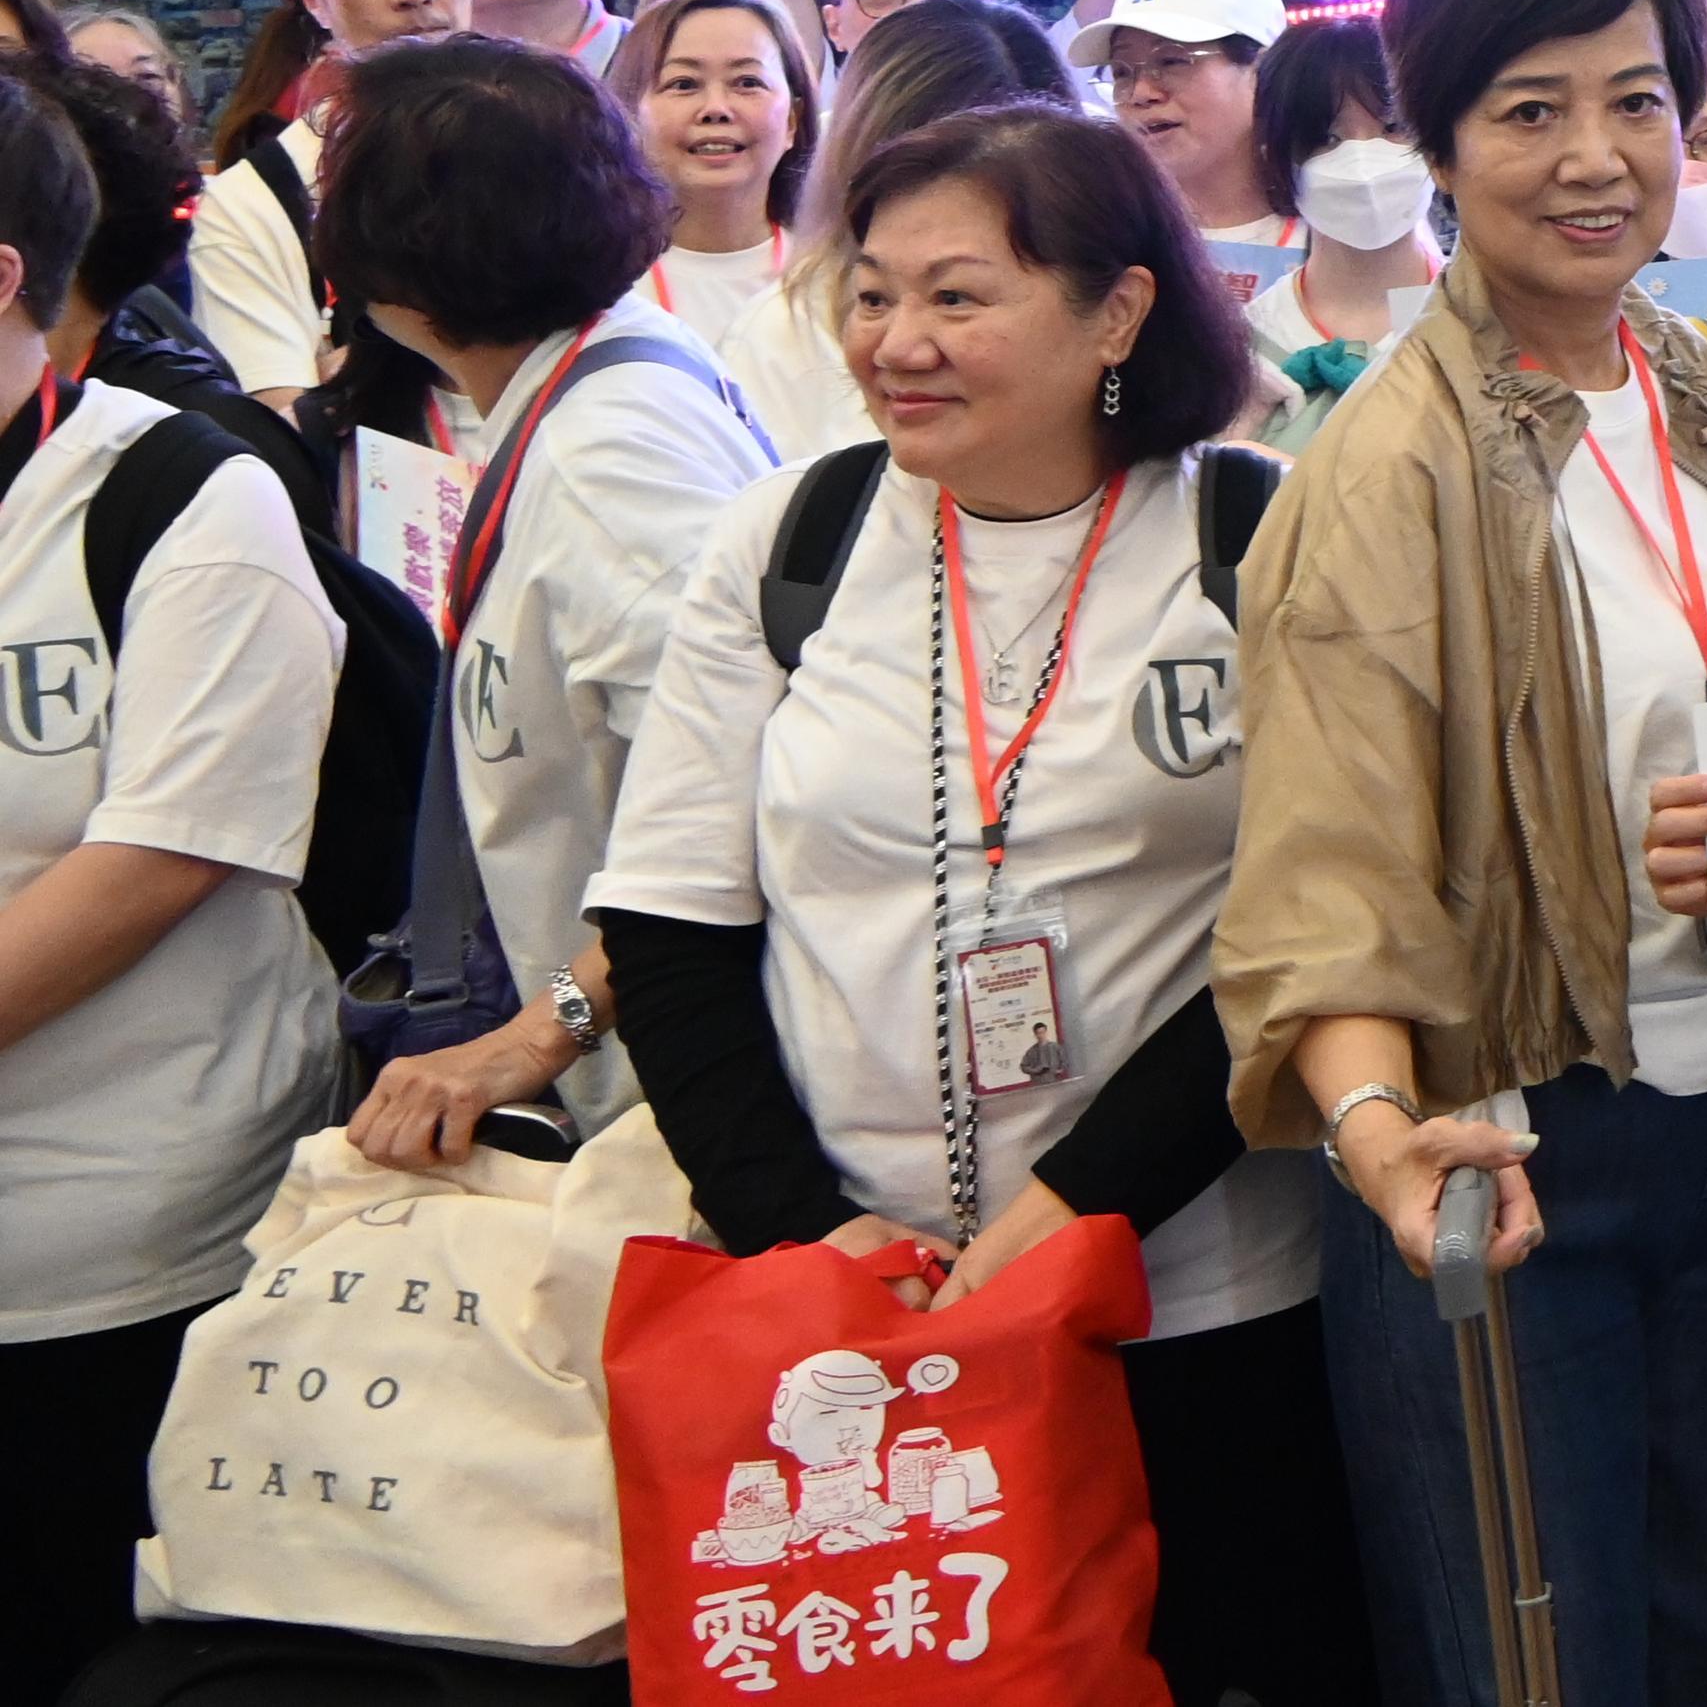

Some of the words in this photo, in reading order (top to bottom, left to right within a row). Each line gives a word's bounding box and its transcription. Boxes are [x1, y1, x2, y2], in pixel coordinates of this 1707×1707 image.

[248, 1359, 400, 1410] TOO
[206, 1457, 399, 1512] LATE
[692, 1551, 1010, 1693] 零食来了
